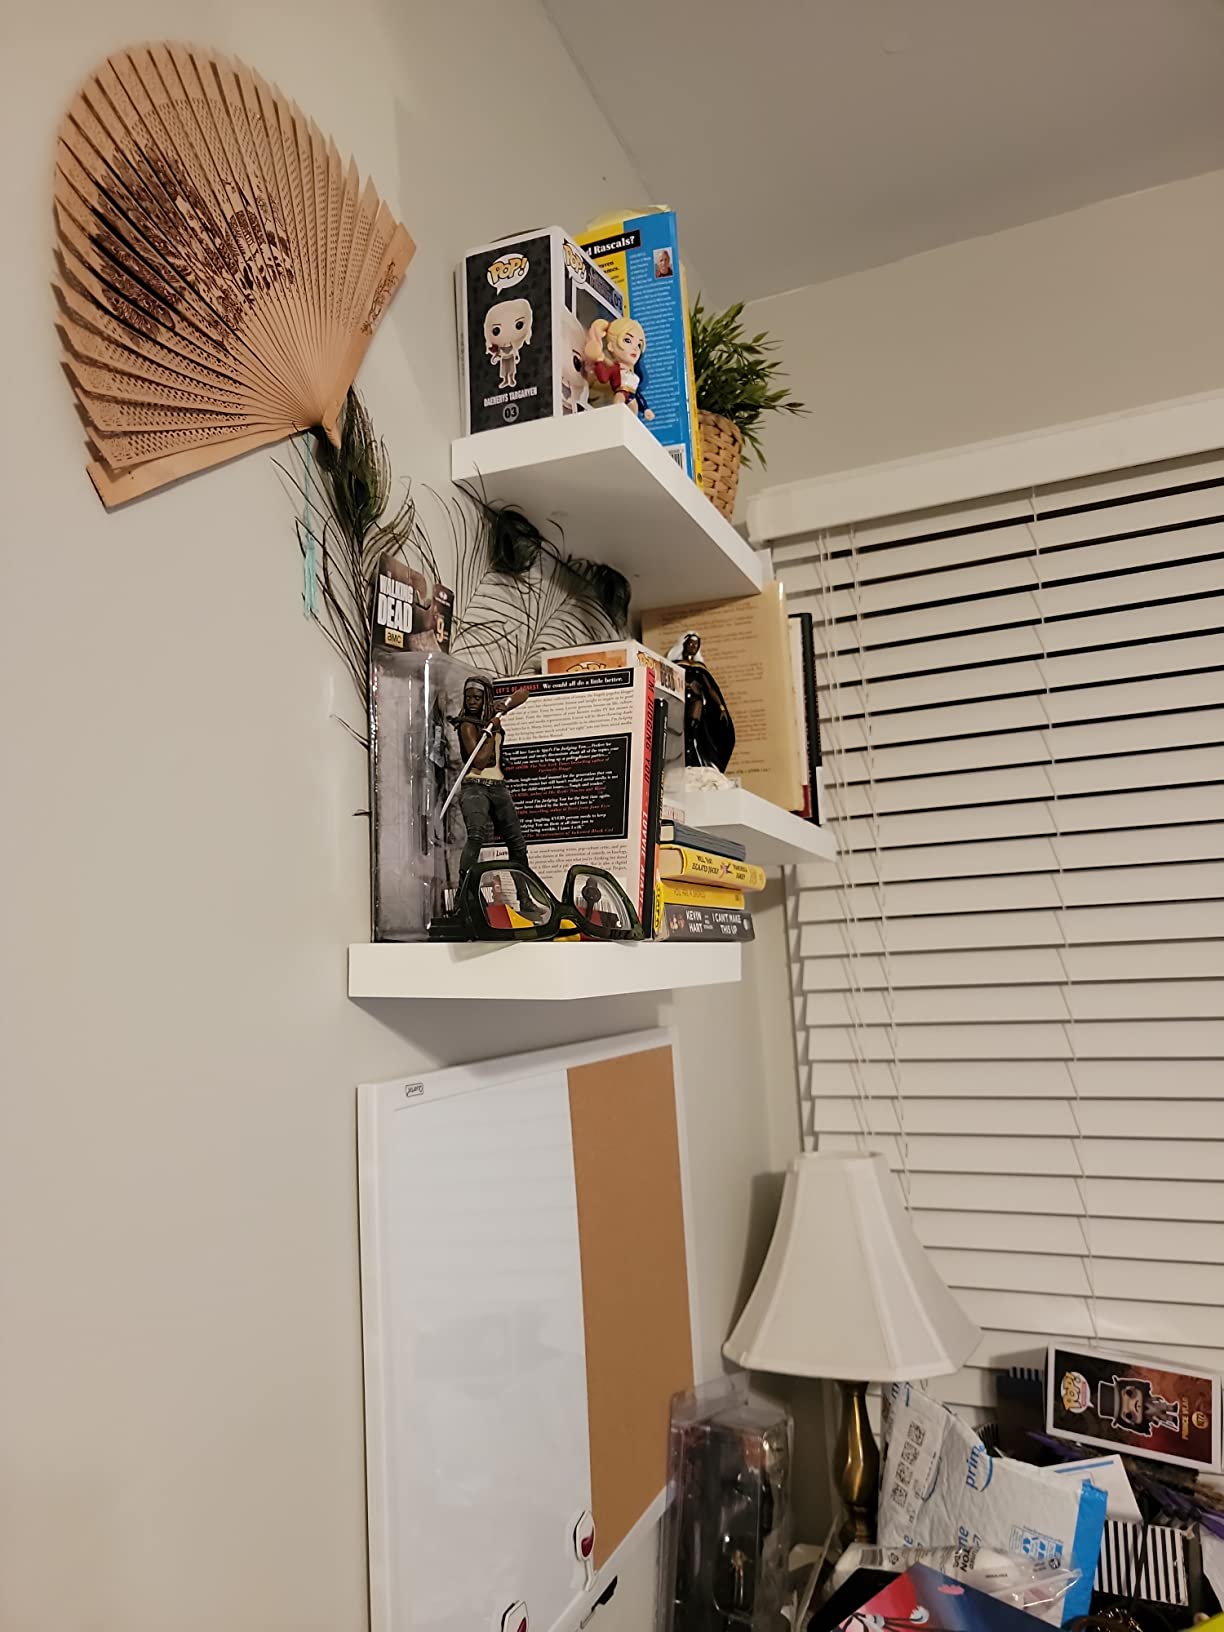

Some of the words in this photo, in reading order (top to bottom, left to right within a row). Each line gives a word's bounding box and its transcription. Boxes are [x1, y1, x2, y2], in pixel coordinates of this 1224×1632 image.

[593, 235, 635, 254] Rascals?
[488, 257, 528, 284] POP!
[504, 406, 517, 419] 03
[377, 593, 413, 634] DEAD
[552, 680, 567, 688] could
[604, 674, 622, 683] better.
[645, 696, 654, 751] JUDGING
[685, 910, 702, 921] KEVIN
[688, 922, 703, 933] HART
[720, 924, 731, 935] THIS
[731, 925, 738, 935] UP
[1062, 1371, 1081, 1410] POP!
